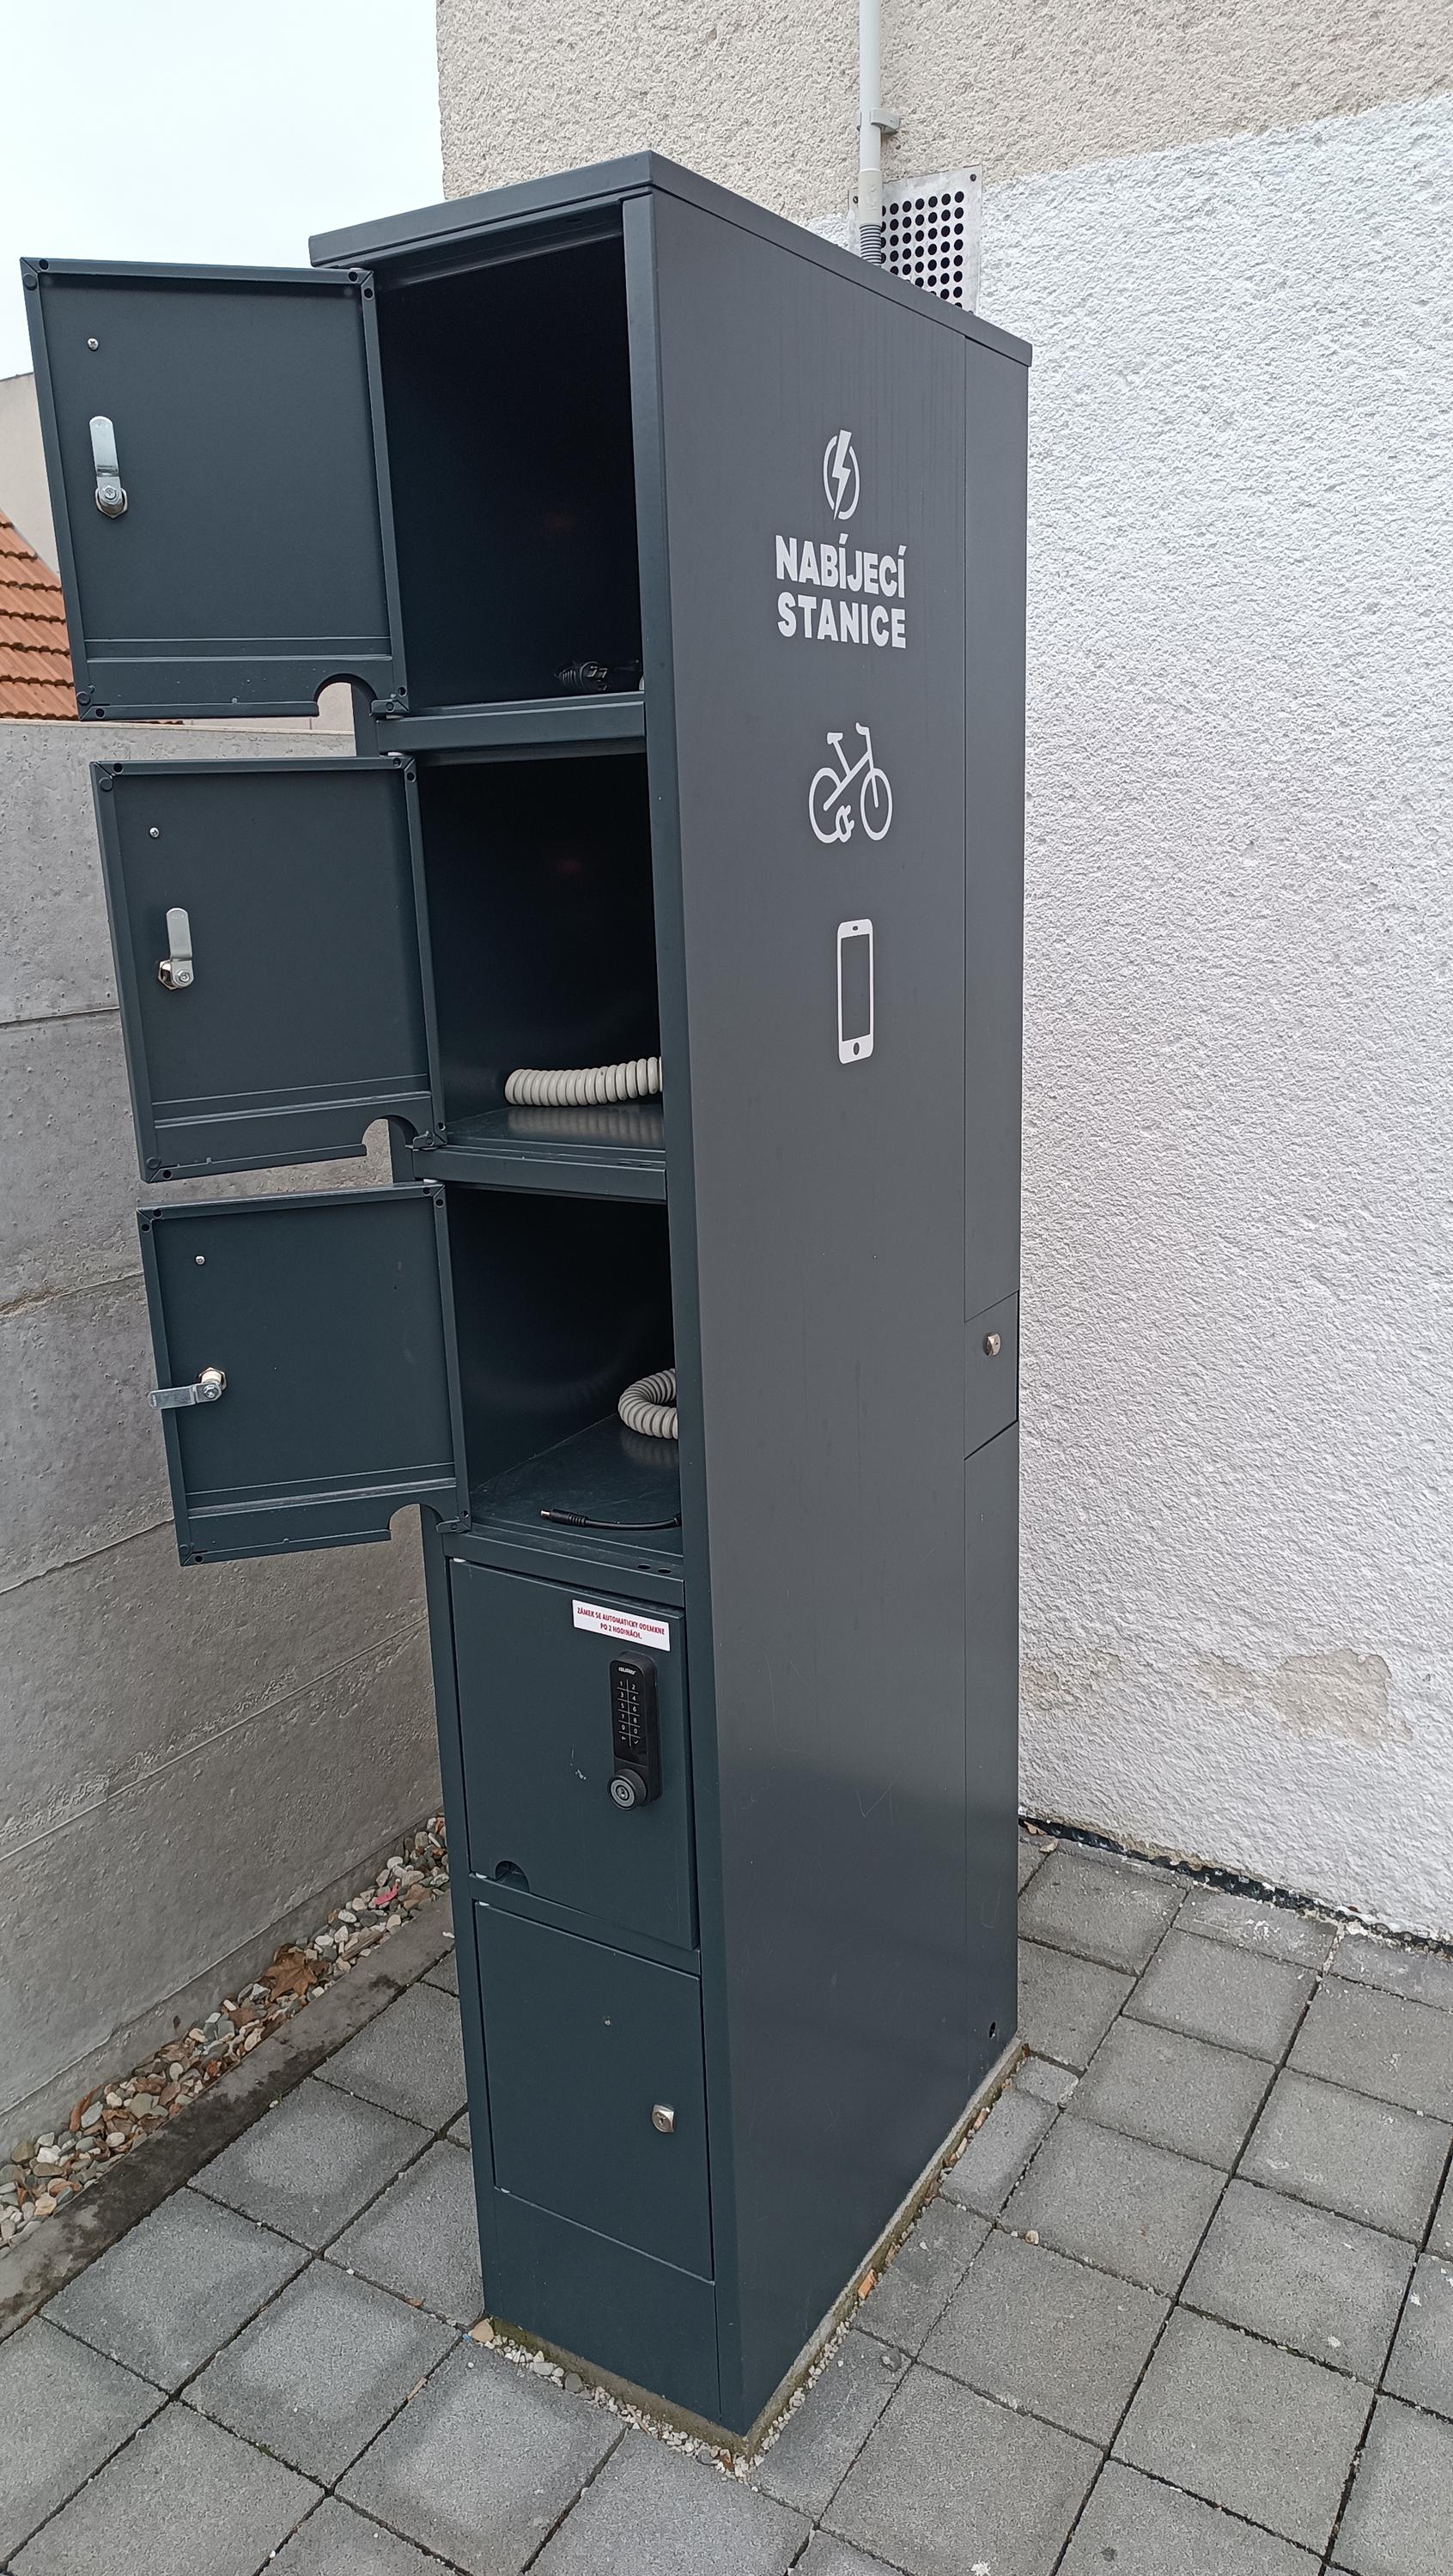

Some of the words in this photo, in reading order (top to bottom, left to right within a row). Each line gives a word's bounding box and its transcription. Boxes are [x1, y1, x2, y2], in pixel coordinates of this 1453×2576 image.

[775, 532, 907, 598] NABÍJECÍ
[777, 592, 906, 649] STANICE
[577, 1607, 595, 1618] ZÁMEK
[602, 1613, 638, 1628] AUTOMATICKY
[639, 1624, 665, 1636] ODEMKNE
